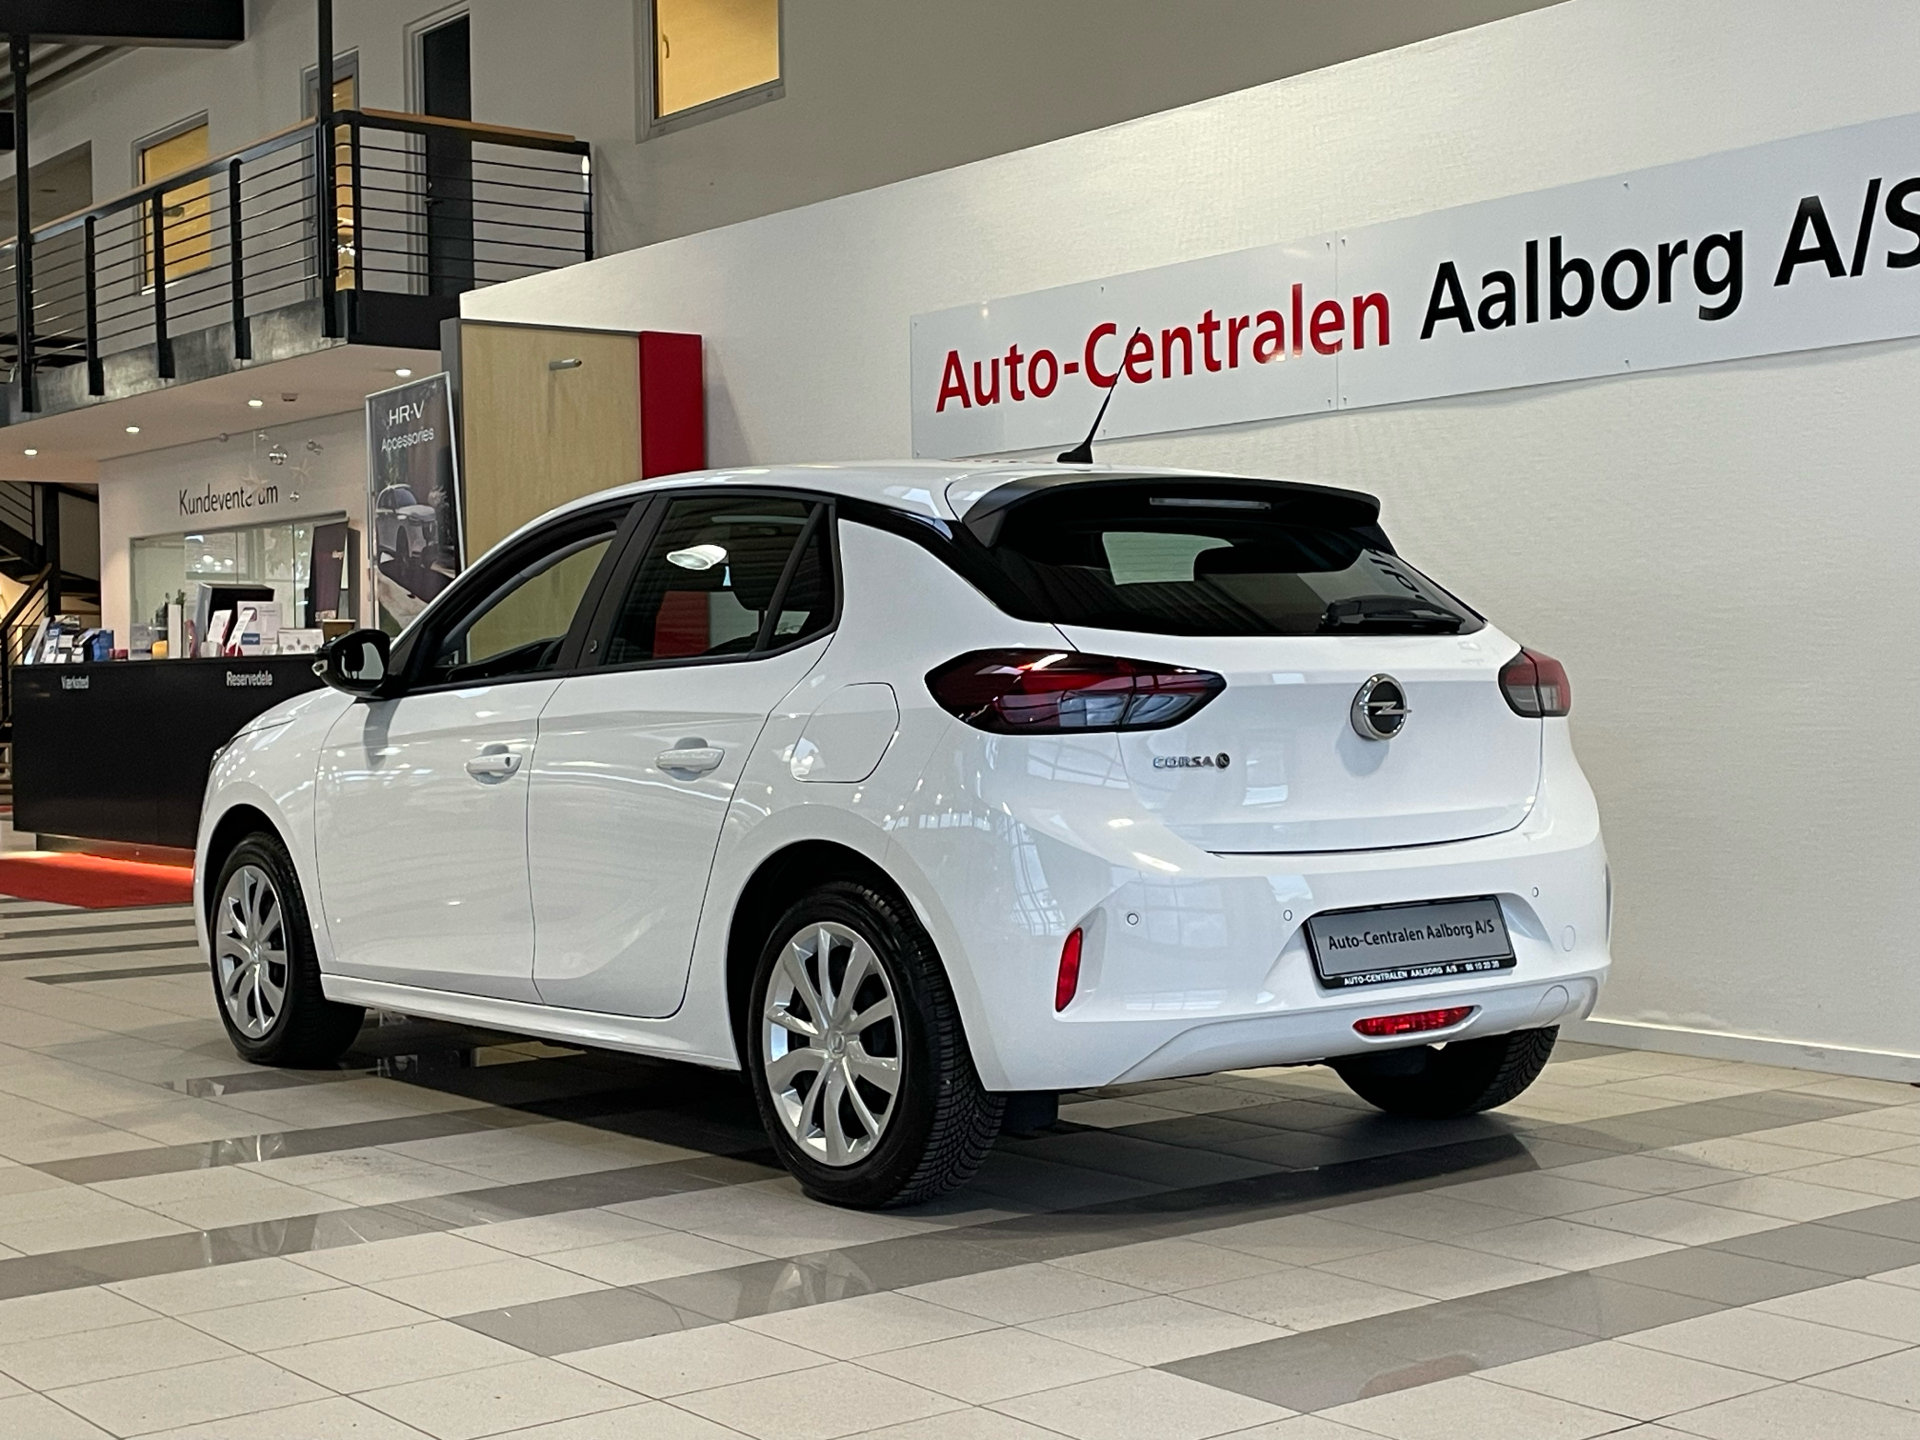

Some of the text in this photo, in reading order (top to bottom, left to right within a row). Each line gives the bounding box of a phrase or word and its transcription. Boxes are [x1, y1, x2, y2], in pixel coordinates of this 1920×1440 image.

[935, 176, 1920, 413] Auto-Centralen Aalborg A/S
[381, 426, 435, 452] Accessories
[179, 482, 279, 516] Kundeventum
[226, 669, 273, 687] Reservedele
[1328, 918, 1495, 951] Auto-Centralen Aalborg A/S
[1343, 970, 1408, 986] AUTO-CENTRALEN
[1410, 965, 1444, 978] AALBORG
